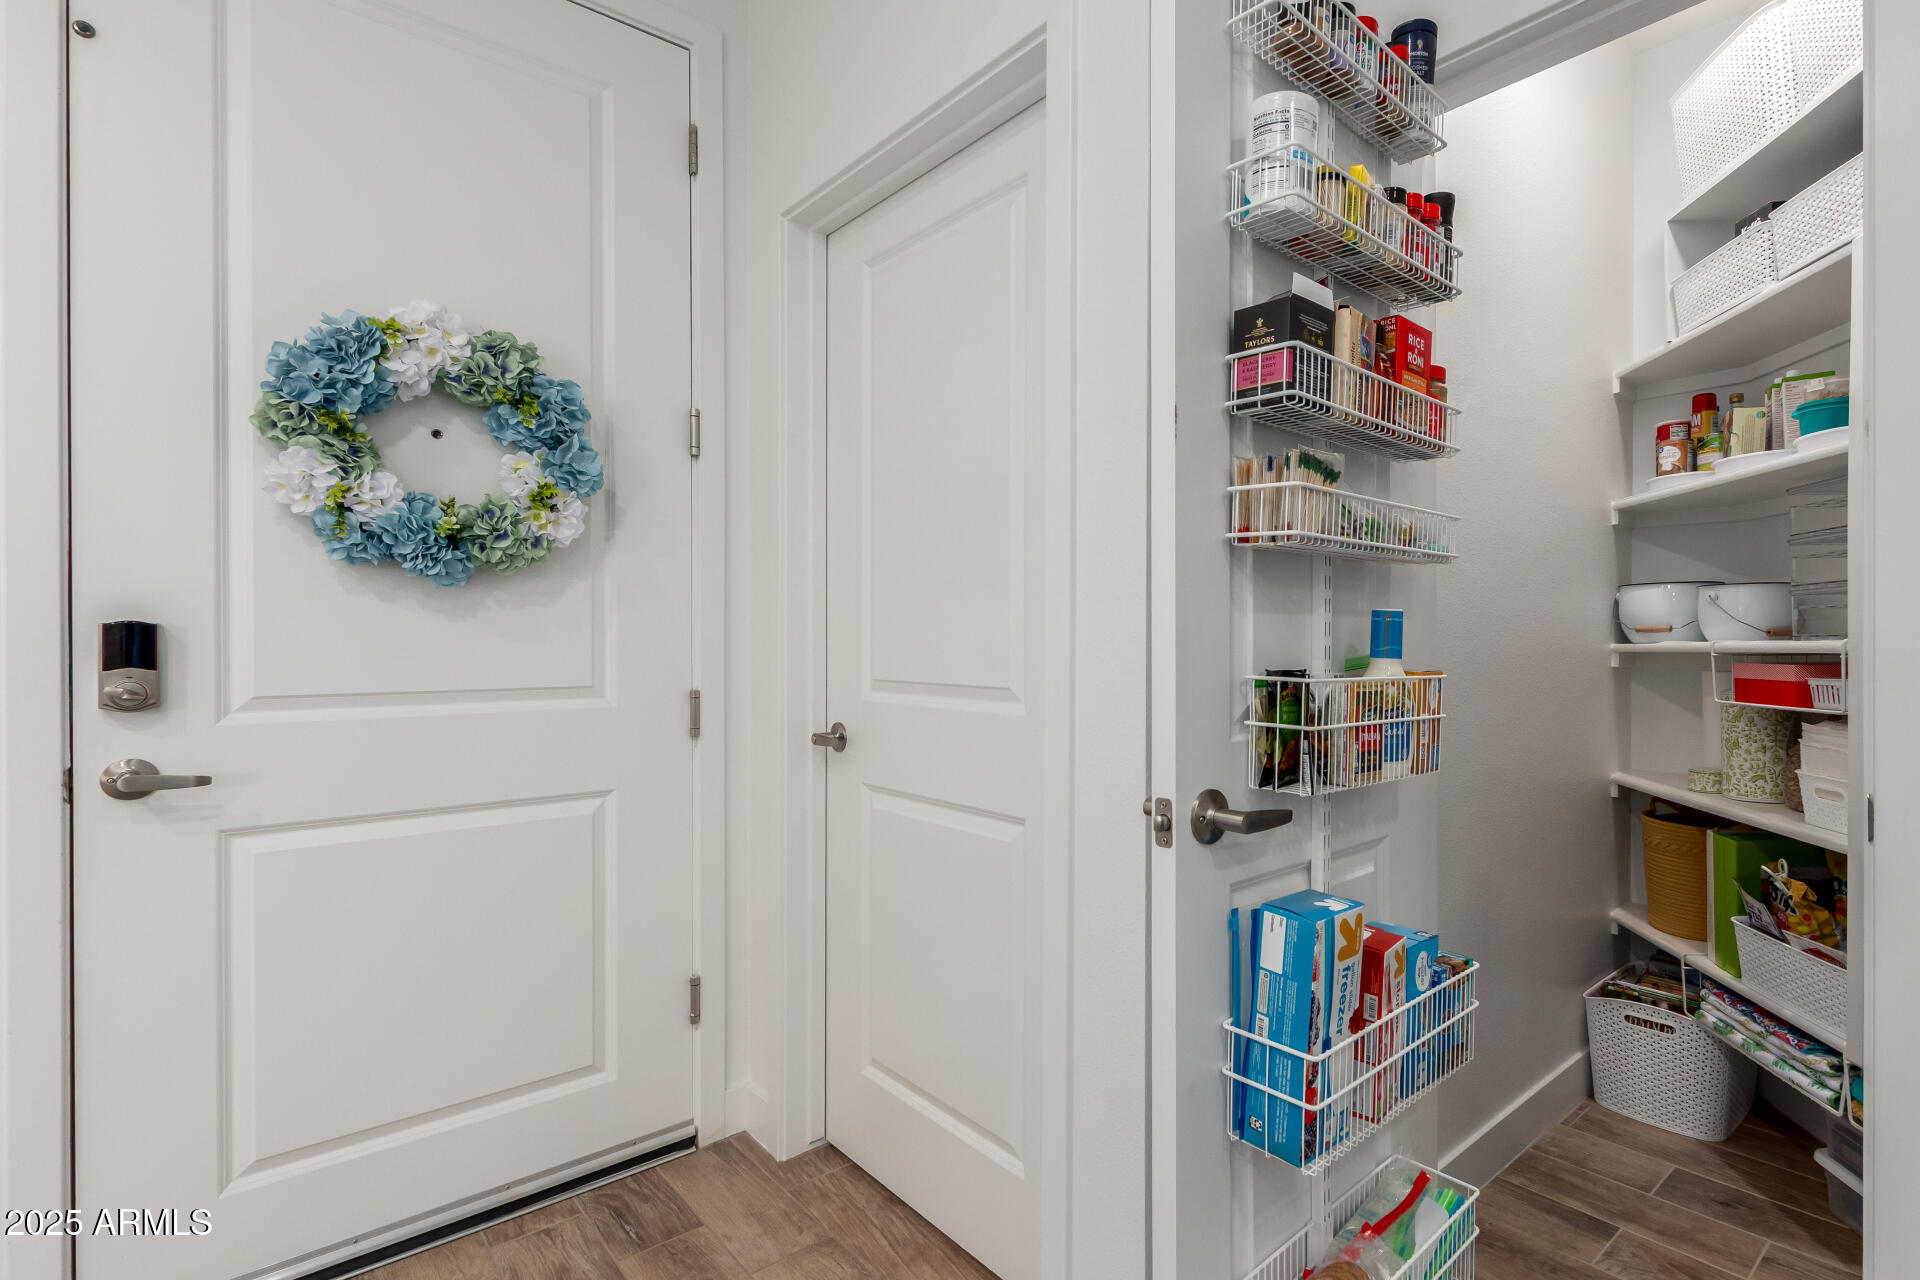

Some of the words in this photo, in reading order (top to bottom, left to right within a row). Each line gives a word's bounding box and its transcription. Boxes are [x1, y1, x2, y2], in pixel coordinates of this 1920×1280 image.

[1244, 335, 1275, 349] TAYLORS
[1408, 333, 1425, 351] RICE
[1407, 351, 1424, 369] RONI
[1336, 965, 1351, 1036] freezer
